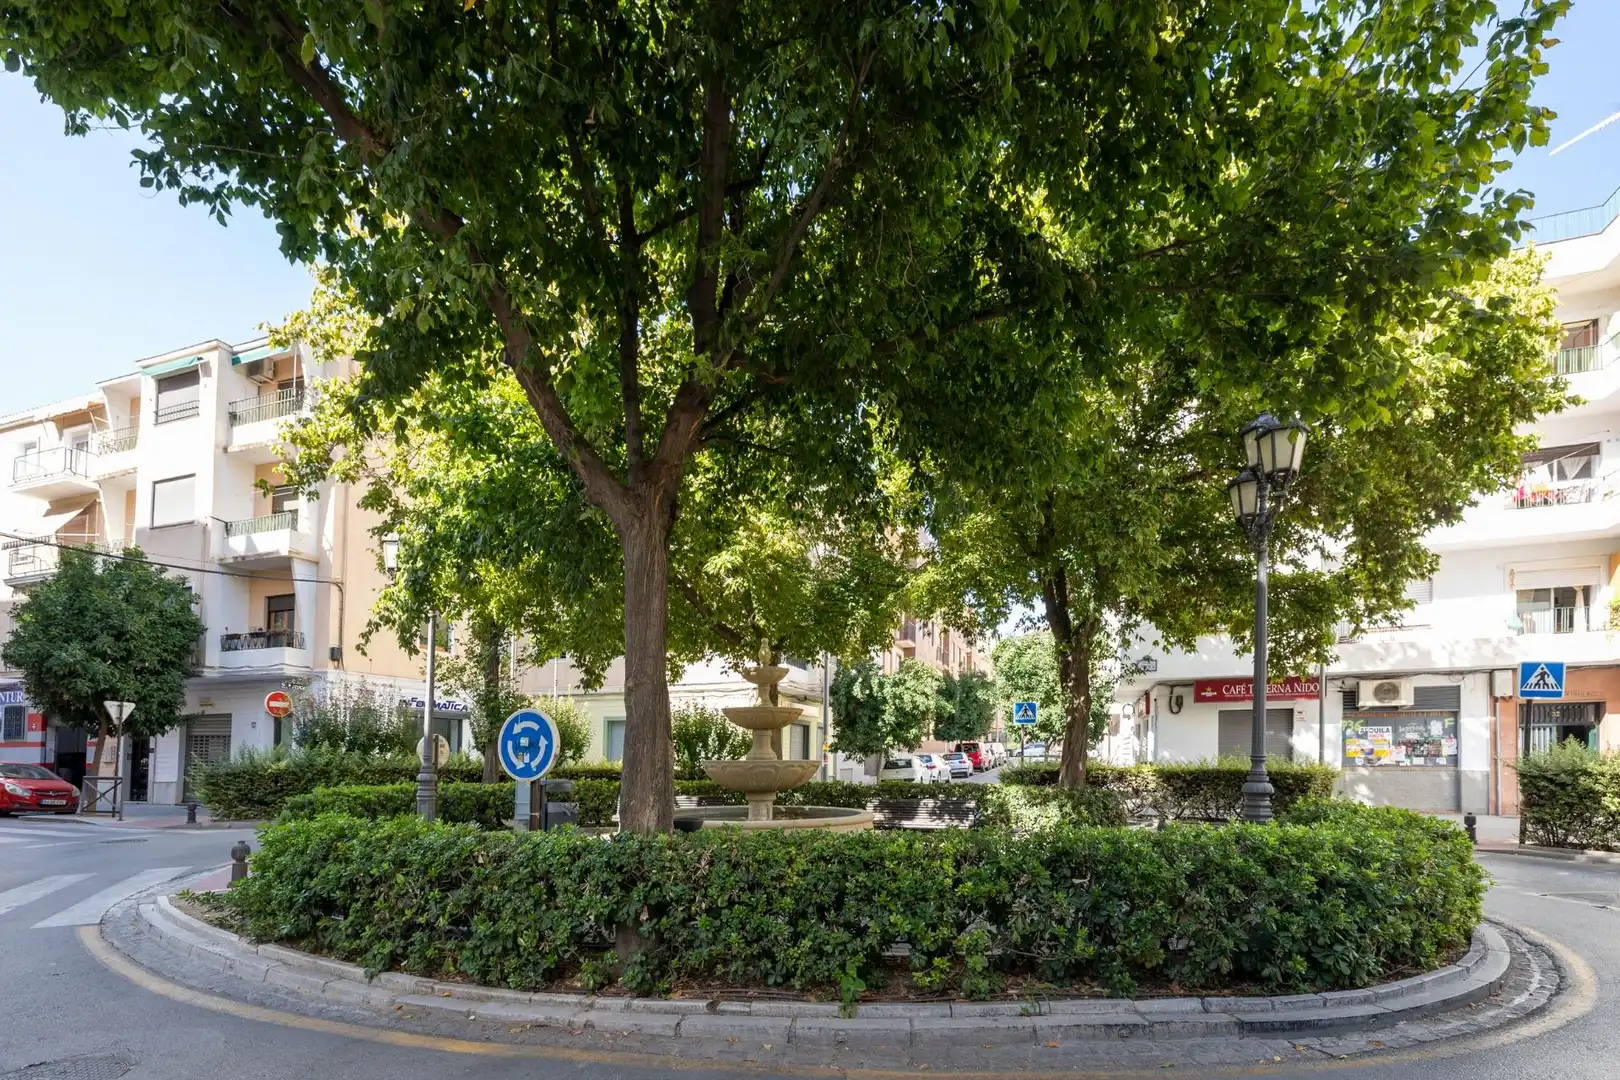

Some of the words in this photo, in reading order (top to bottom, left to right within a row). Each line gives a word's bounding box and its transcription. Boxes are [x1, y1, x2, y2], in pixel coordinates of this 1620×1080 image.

[1222, 682, 1246, 695] CAFÉ
[1247, 683, 1291, 694] TERNA
[1293, 682, 1320, 693] NIDO
[398, 697, 468, 712] INFOMATICA
